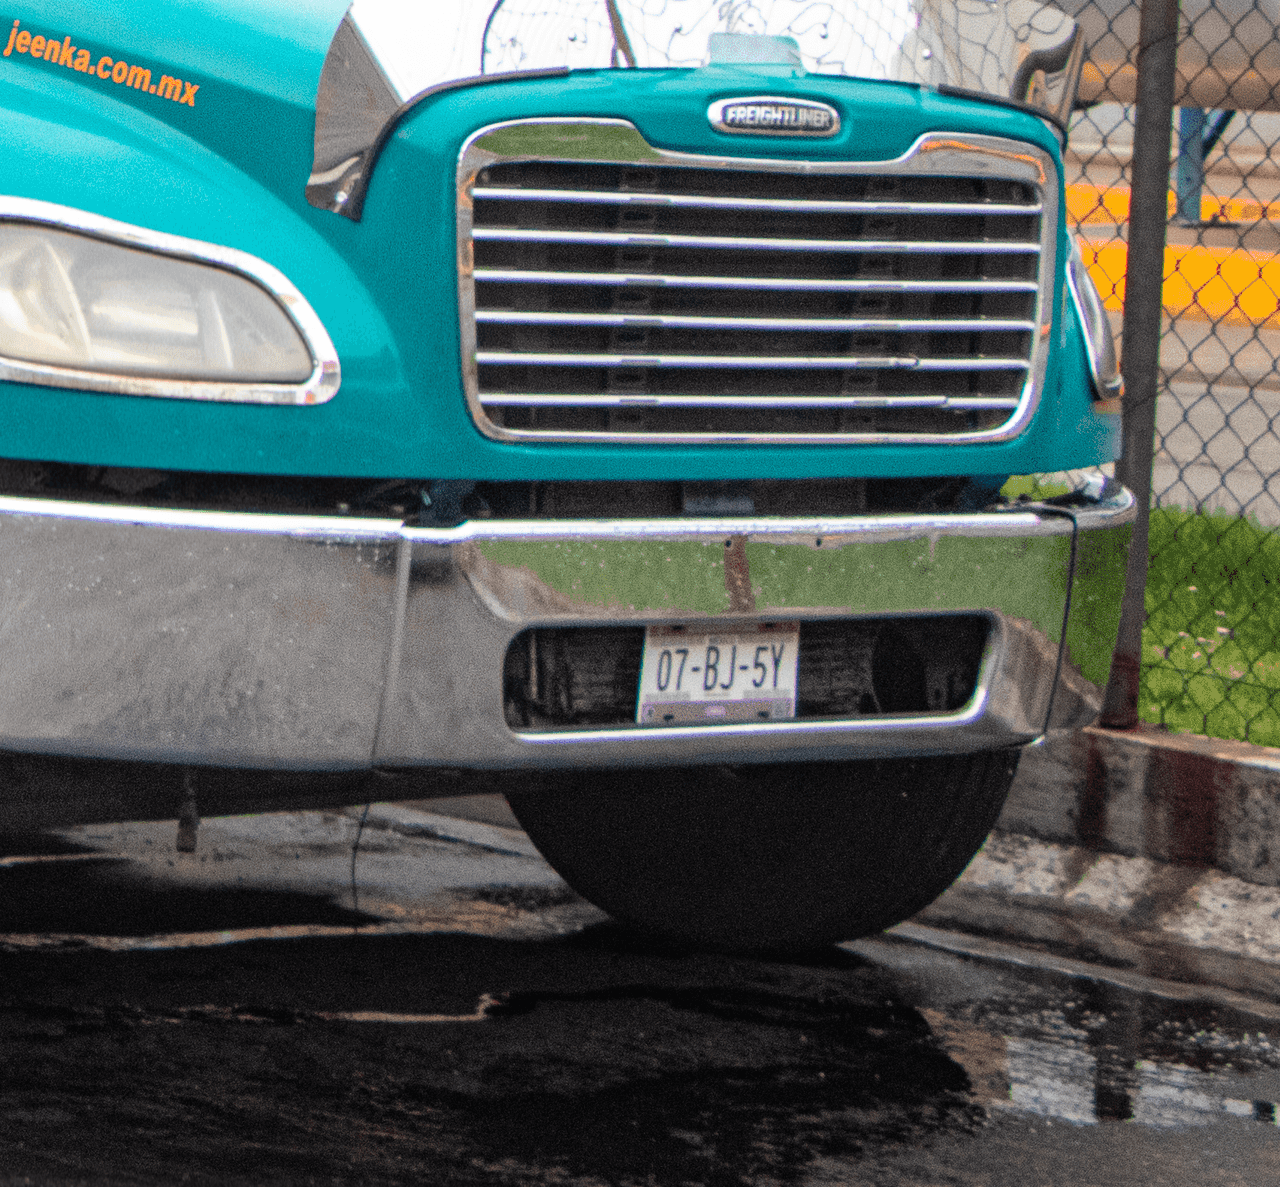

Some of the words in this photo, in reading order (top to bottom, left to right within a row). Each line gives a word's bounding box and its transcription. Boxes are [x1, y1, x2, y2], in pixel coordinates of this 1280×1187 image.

[3, 19, 200, 107] jeenka.com.mx
[726, 105, 832, 128] FREIGHTLINER
[656, 641, 785, 692] 07-BJ-5Y
